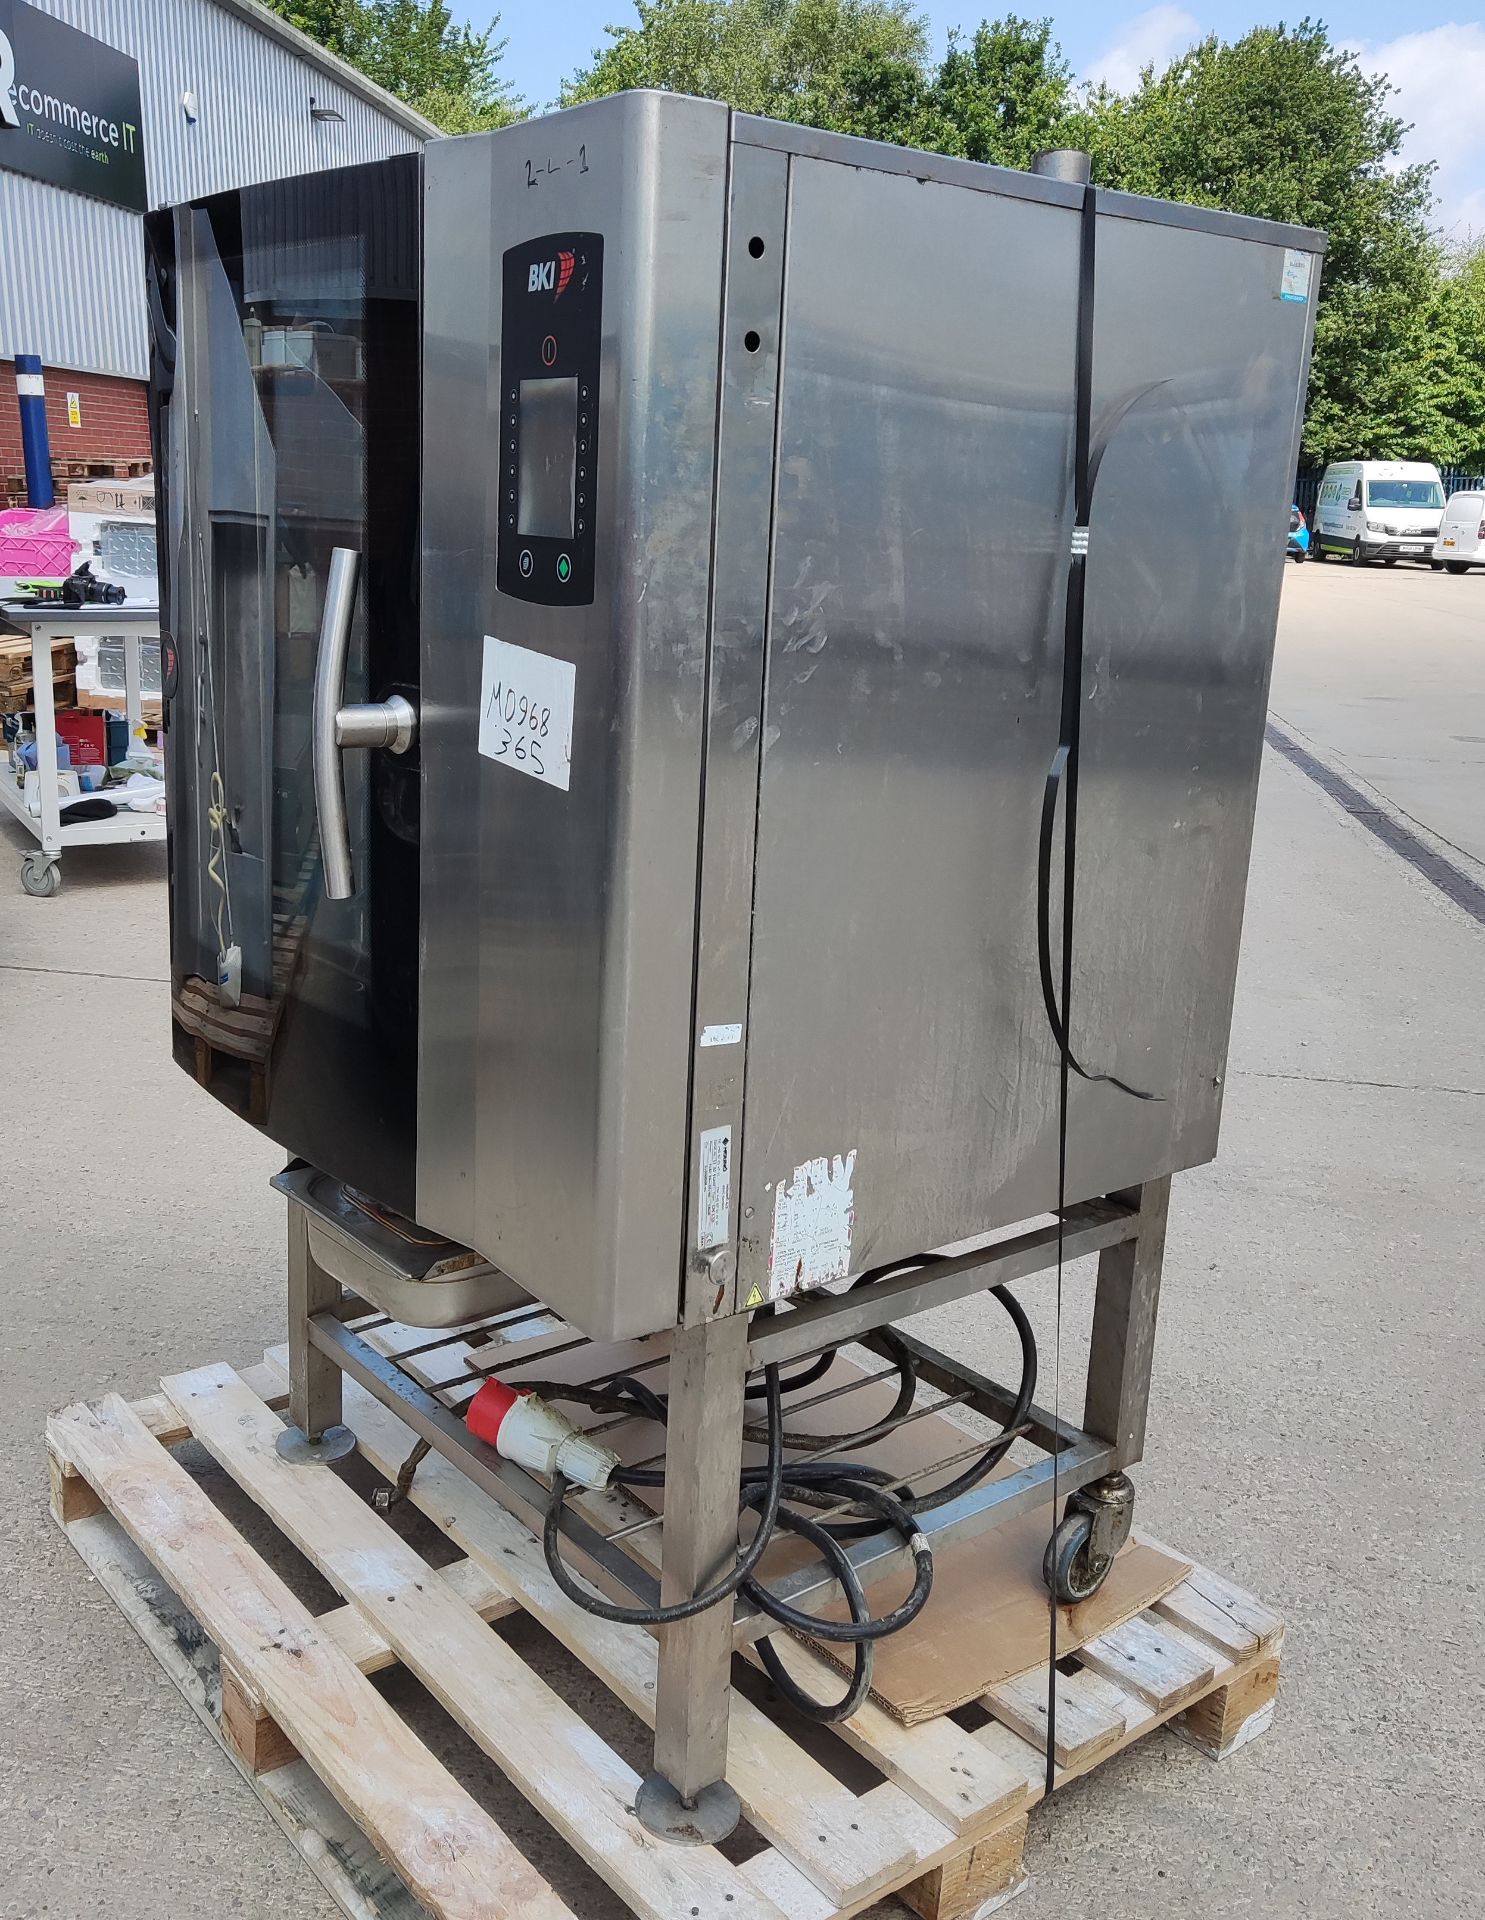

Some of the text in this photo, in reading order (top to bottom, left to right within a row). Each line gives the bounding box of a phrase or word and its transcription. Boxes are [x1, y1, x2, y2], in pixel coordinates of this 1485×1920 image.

[26, 122, 34, 136] IT
[90, 149, 109, 165] earth
[122, 121, 136, 154] IT
[527, 261, 556, 292] BKI
[487, 681, 551, 737] M0968
[494, 728, 545, 775] 365
